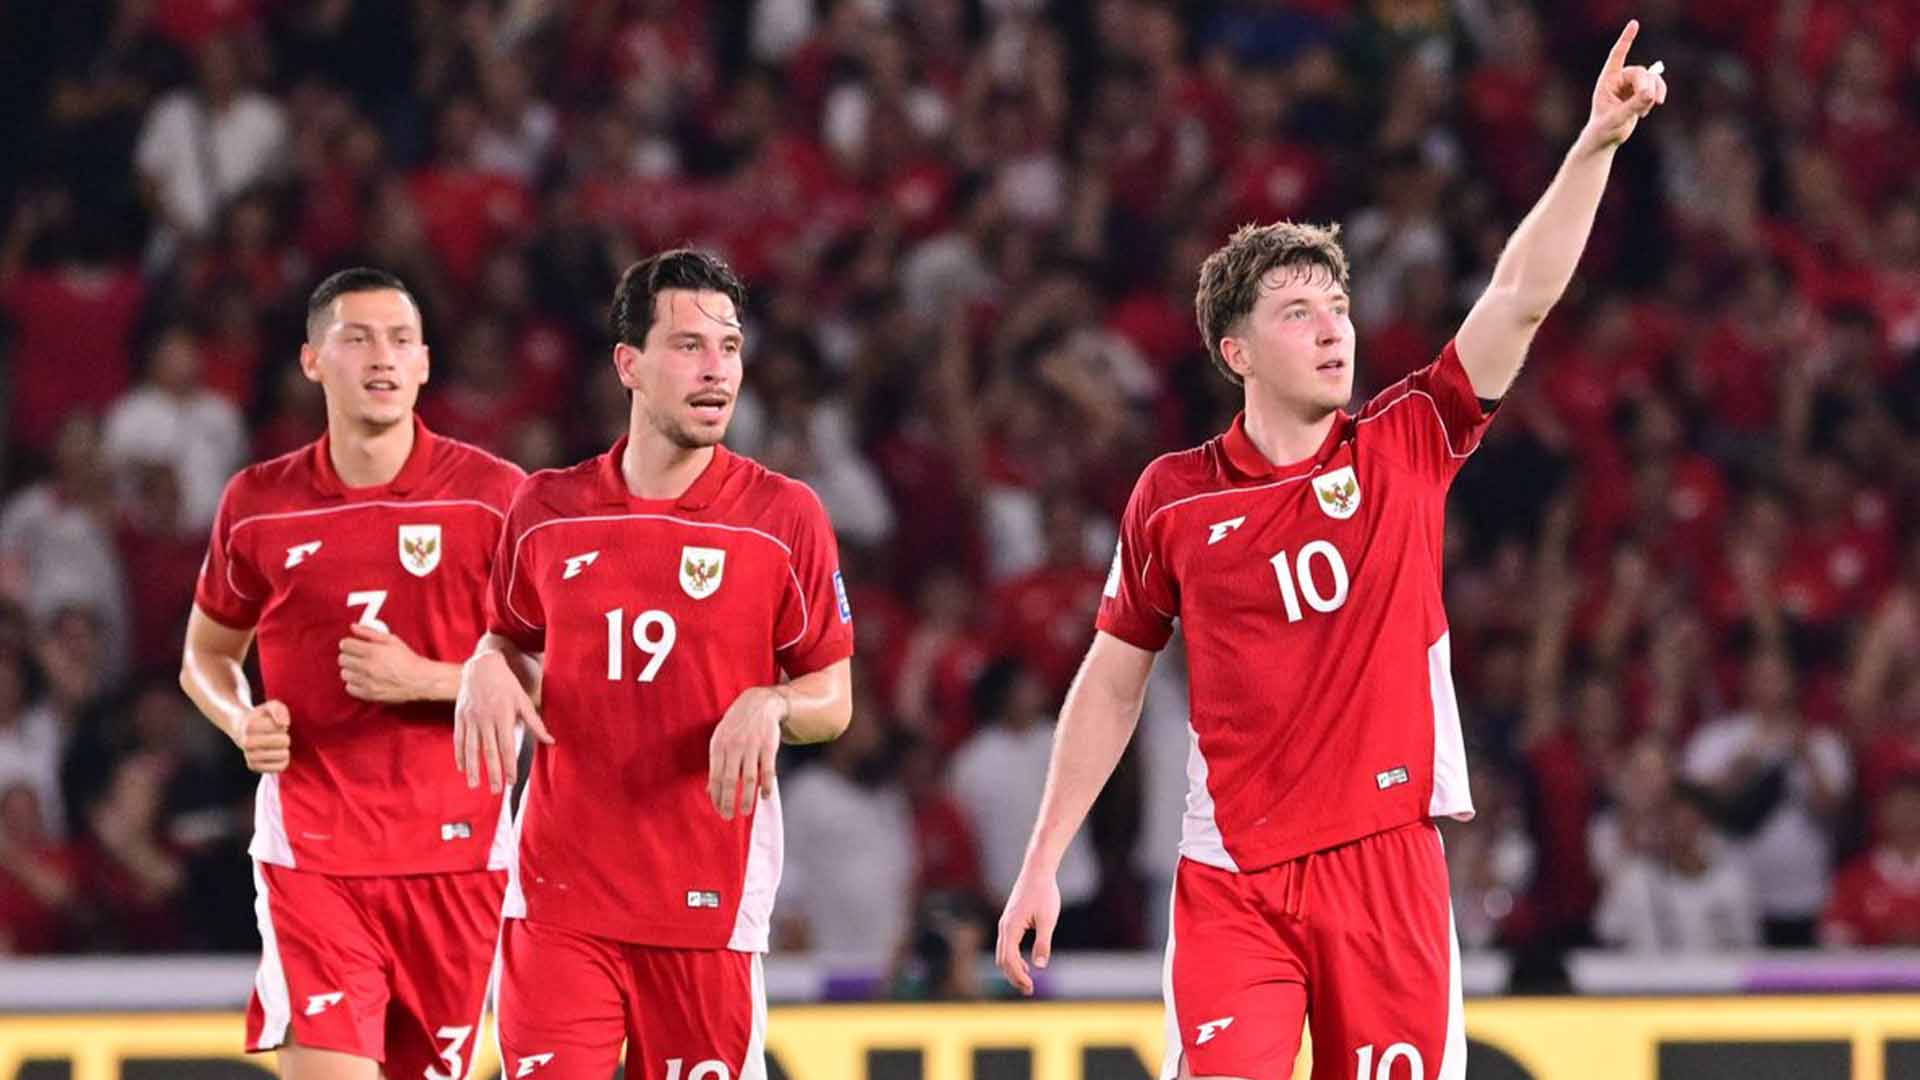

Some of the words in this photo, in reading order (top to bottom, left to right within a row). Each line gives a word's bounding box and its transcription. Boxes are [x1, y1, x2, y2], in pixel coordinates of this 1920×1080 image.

[1269, 540, 1349, 623] 10
[347, 590, 390, 633] 3
[604, 608, 676, 682] 19
[424, 1025, 473, 1080] 3
[1355, 1042, 1424, 1080] 10
